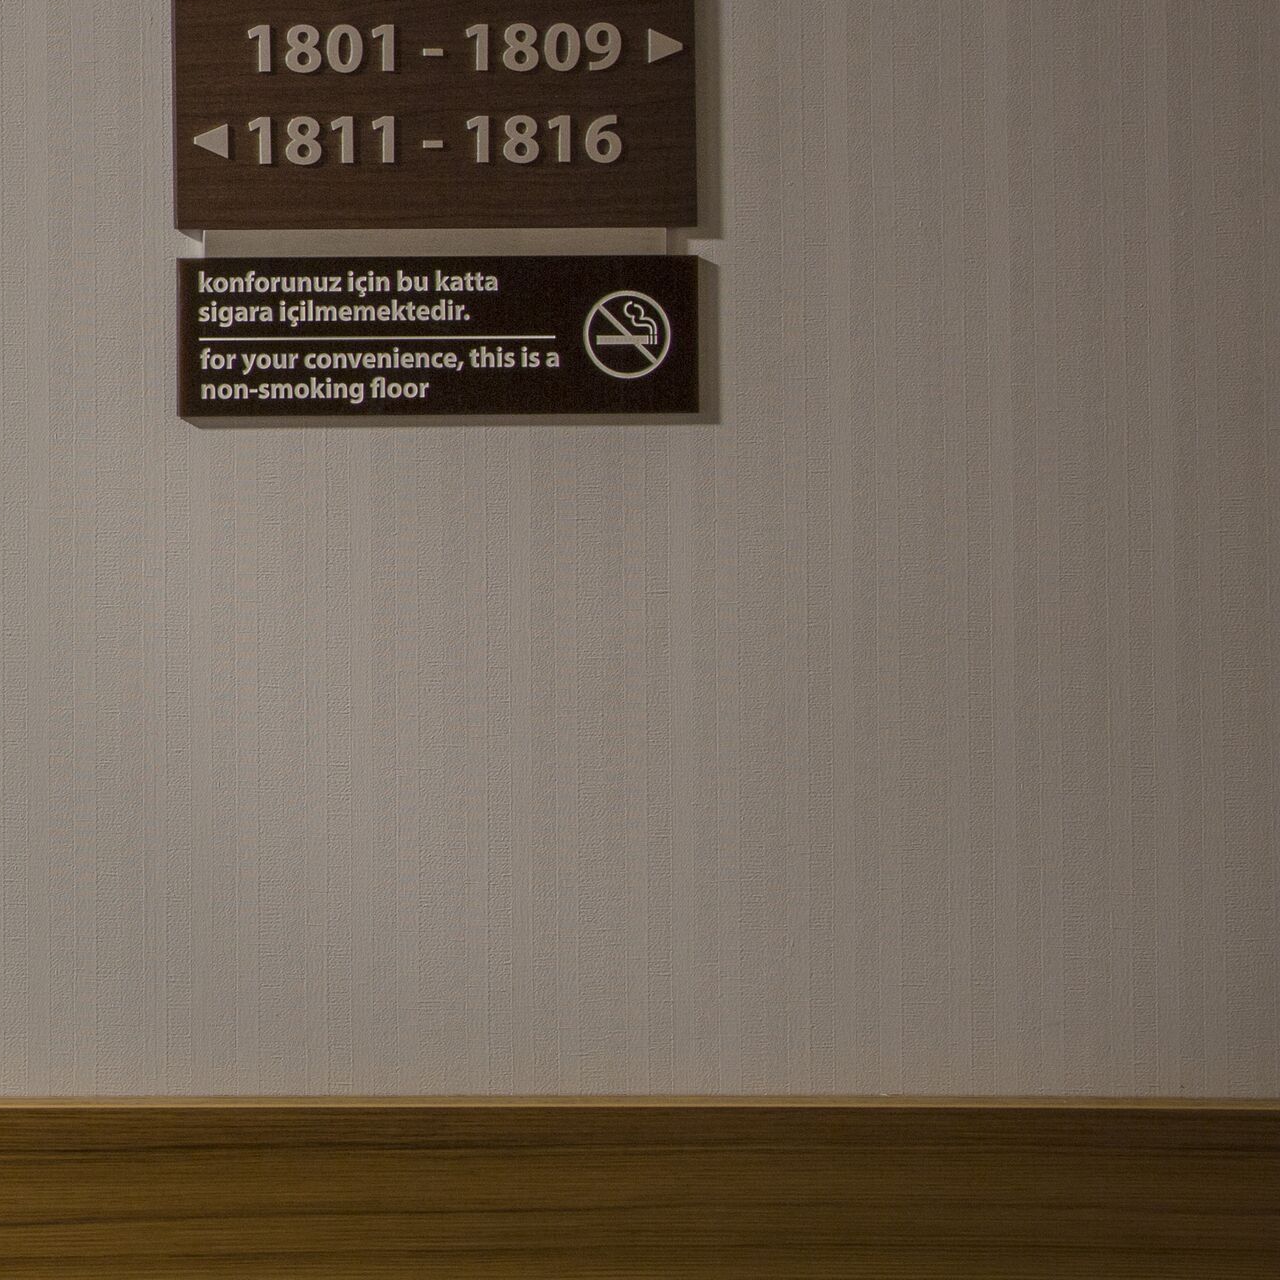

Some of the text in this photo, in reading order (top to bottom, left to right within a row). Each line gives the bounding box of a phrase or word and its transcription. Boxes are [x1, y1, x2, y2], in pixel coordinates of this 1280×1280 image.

[247, 23, 396, 74] 1801
[465, 22, 623, 72] 1809
[247, 115, 396, 166] 1811
[466, 114, 623, 164] 1816
[198, 268, 500, 297] konforunuz için bu katta
[198, 298, 471, 328] sigara içilmemektedir.
[199, 345, 561, 373] for your convenience, this is a
[200, 376, 431, 405] non-smoking floor
